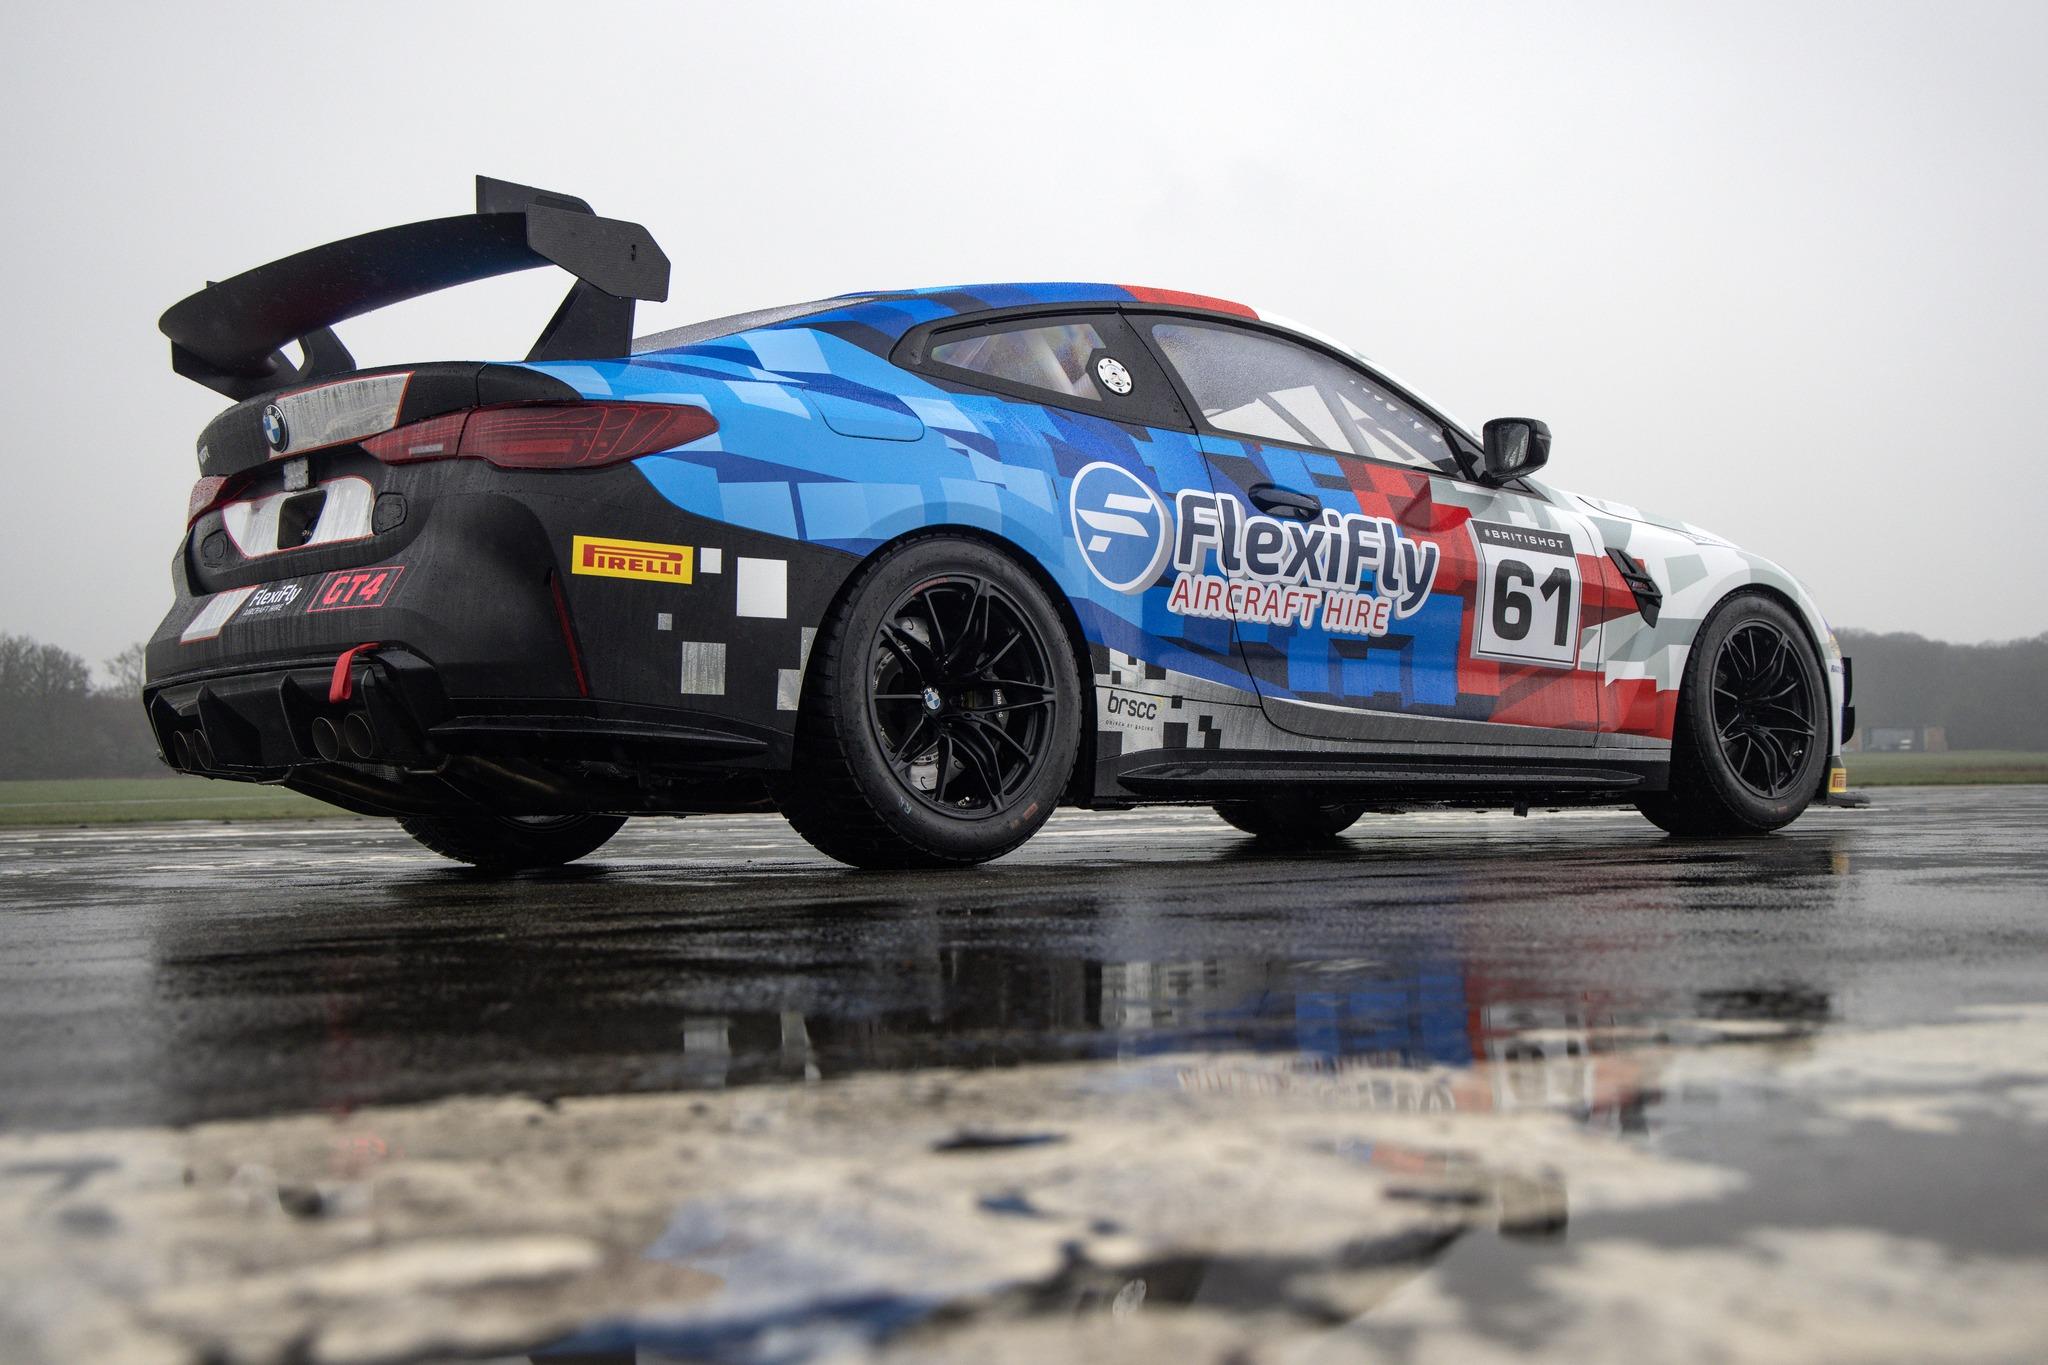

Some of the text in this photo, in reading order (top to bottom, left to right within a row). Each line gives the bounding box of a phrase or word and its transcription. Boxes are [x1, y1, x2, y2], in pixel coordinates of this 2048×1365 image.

[1176, 494, 1438, 614] FlexiFly
[1484, 529, 1564, 549] #BRITISHGT
[583, 544, 684, 575] PIRELLI
[249, 583, 303, 606] FlexiFly
[322, 572, 388, 605] GT4
[1171, 578, 1389, 630] AIRCRAFT HIRE
[1492, 559, 1572, 647] 61
[1107, 690, 1157, 720] brscc
